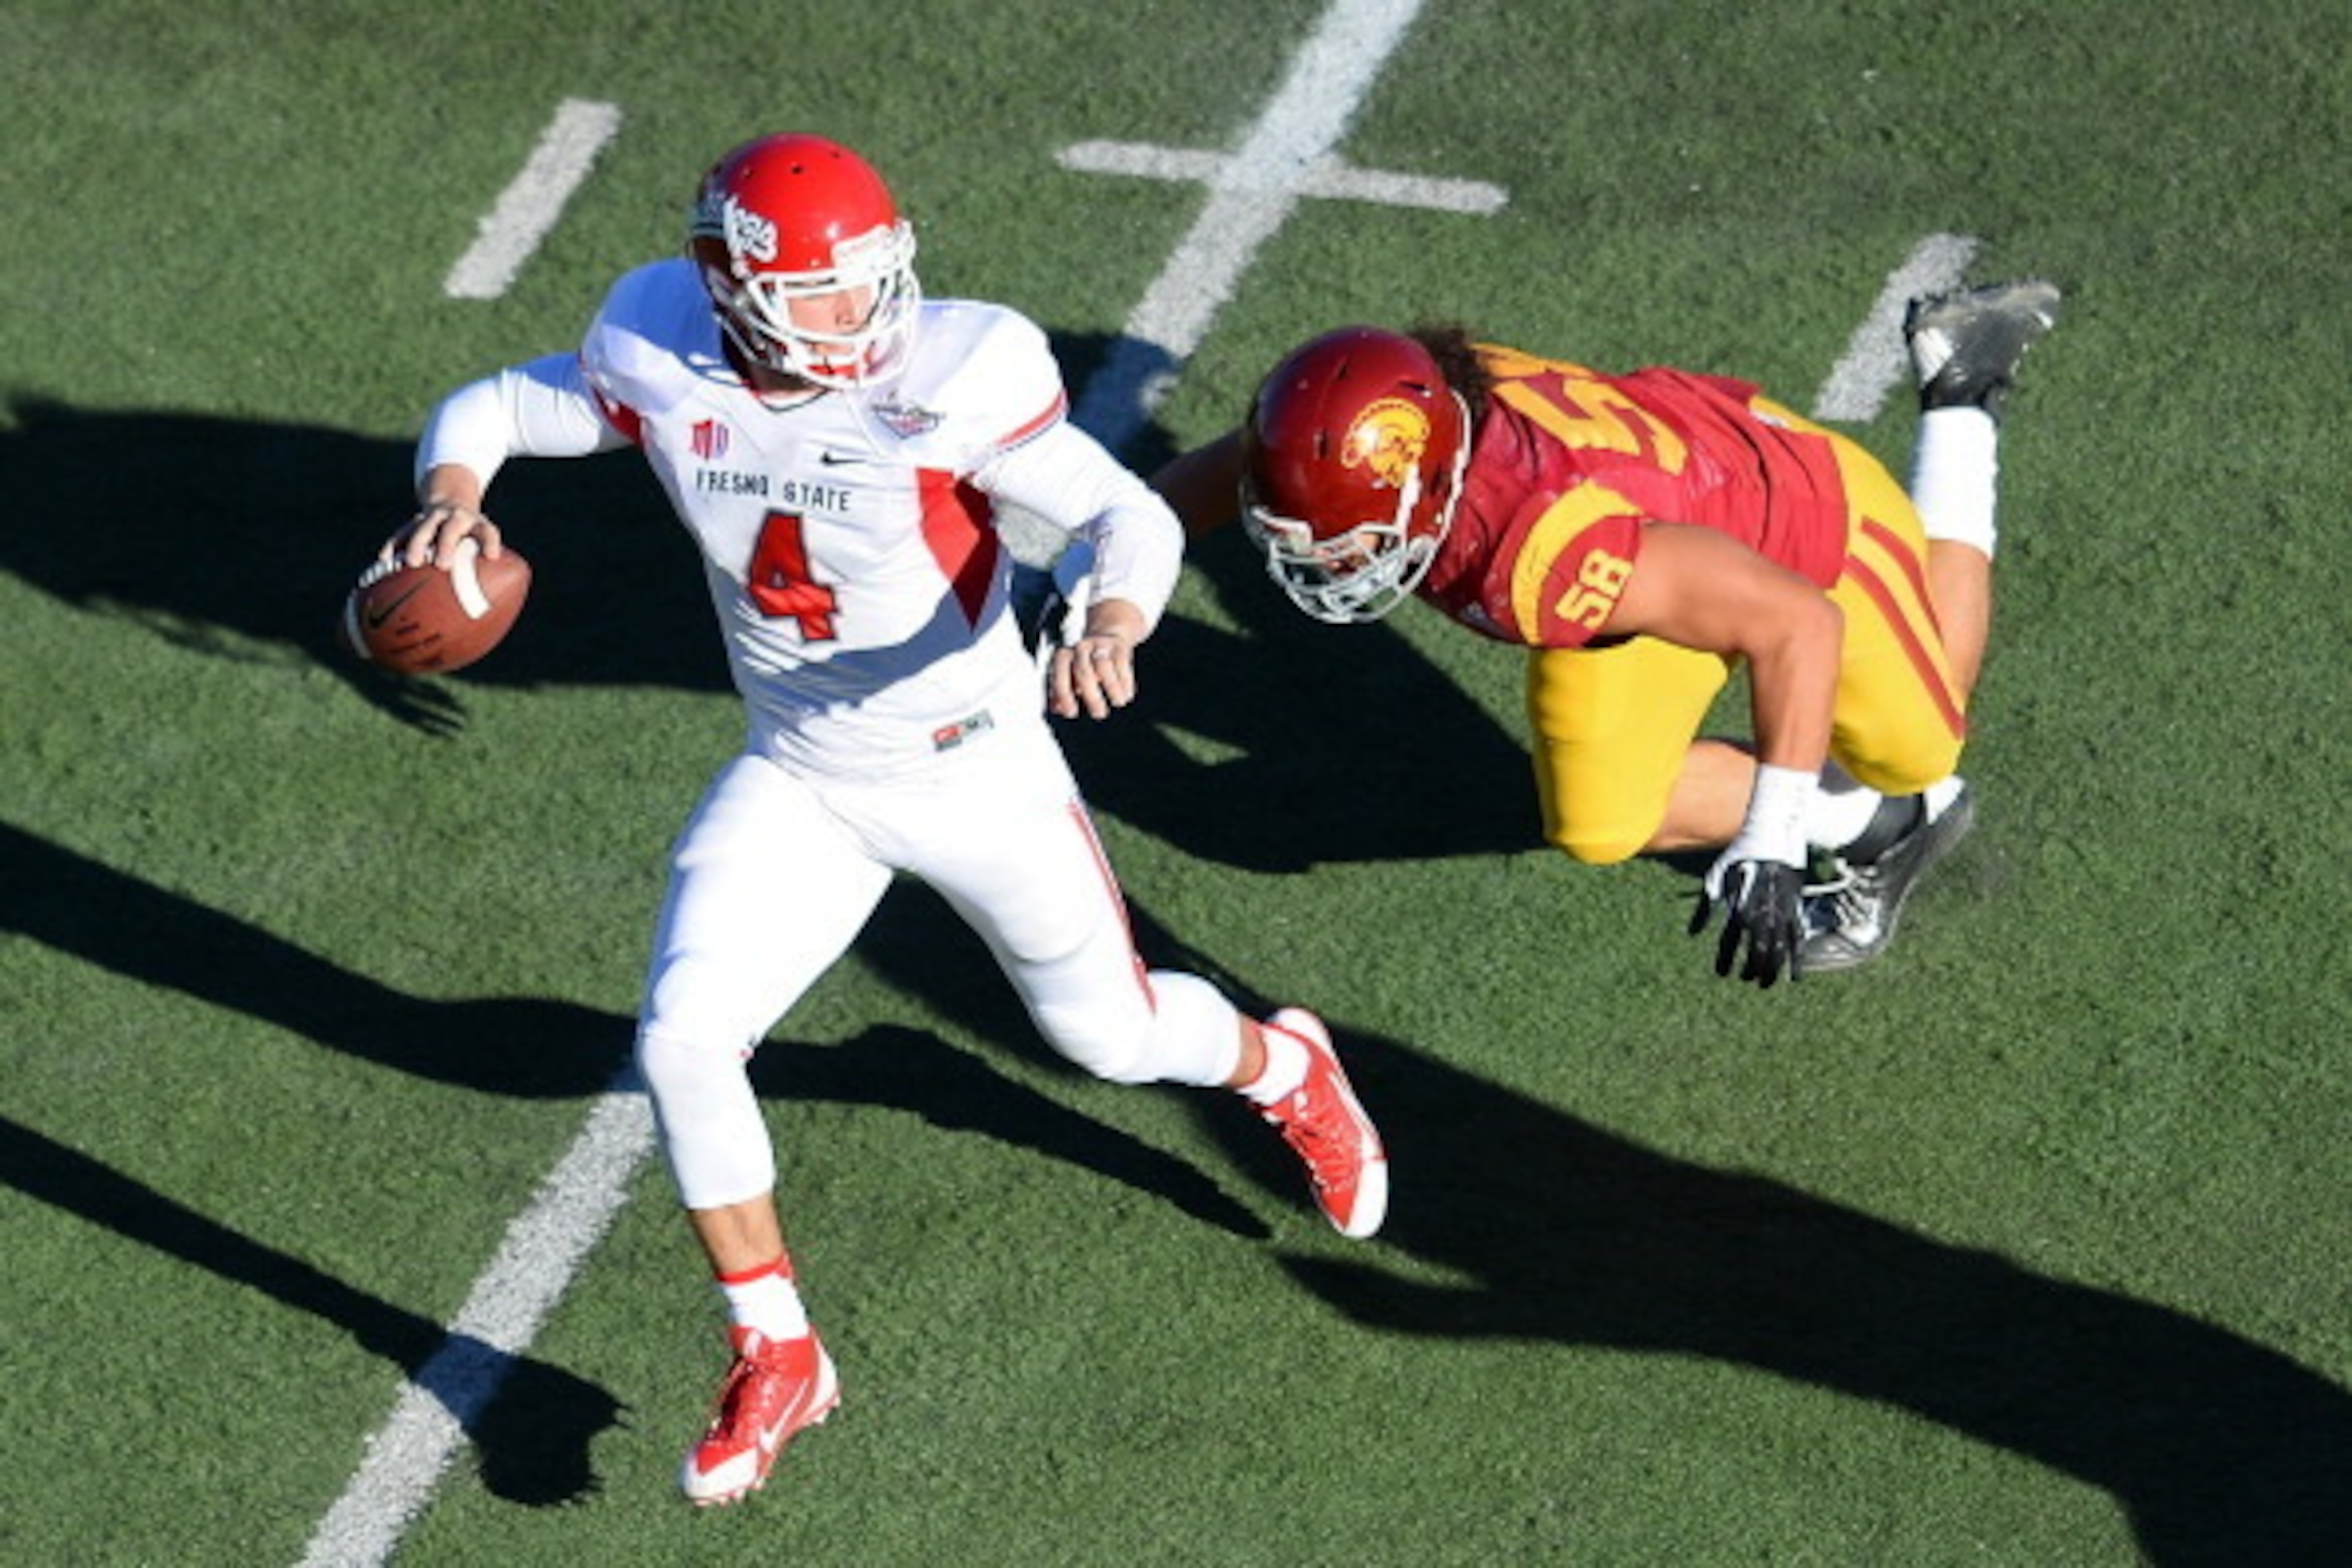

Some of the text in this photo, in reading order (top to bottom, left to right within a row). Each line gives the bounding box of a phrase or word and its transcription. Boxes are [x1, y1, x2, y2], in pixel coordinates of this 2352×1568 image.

[696, 468, 851, 511] FRESNO STATE
[748, 508, 841, 644] 4
[1555, 548, 1633, 631] 58
